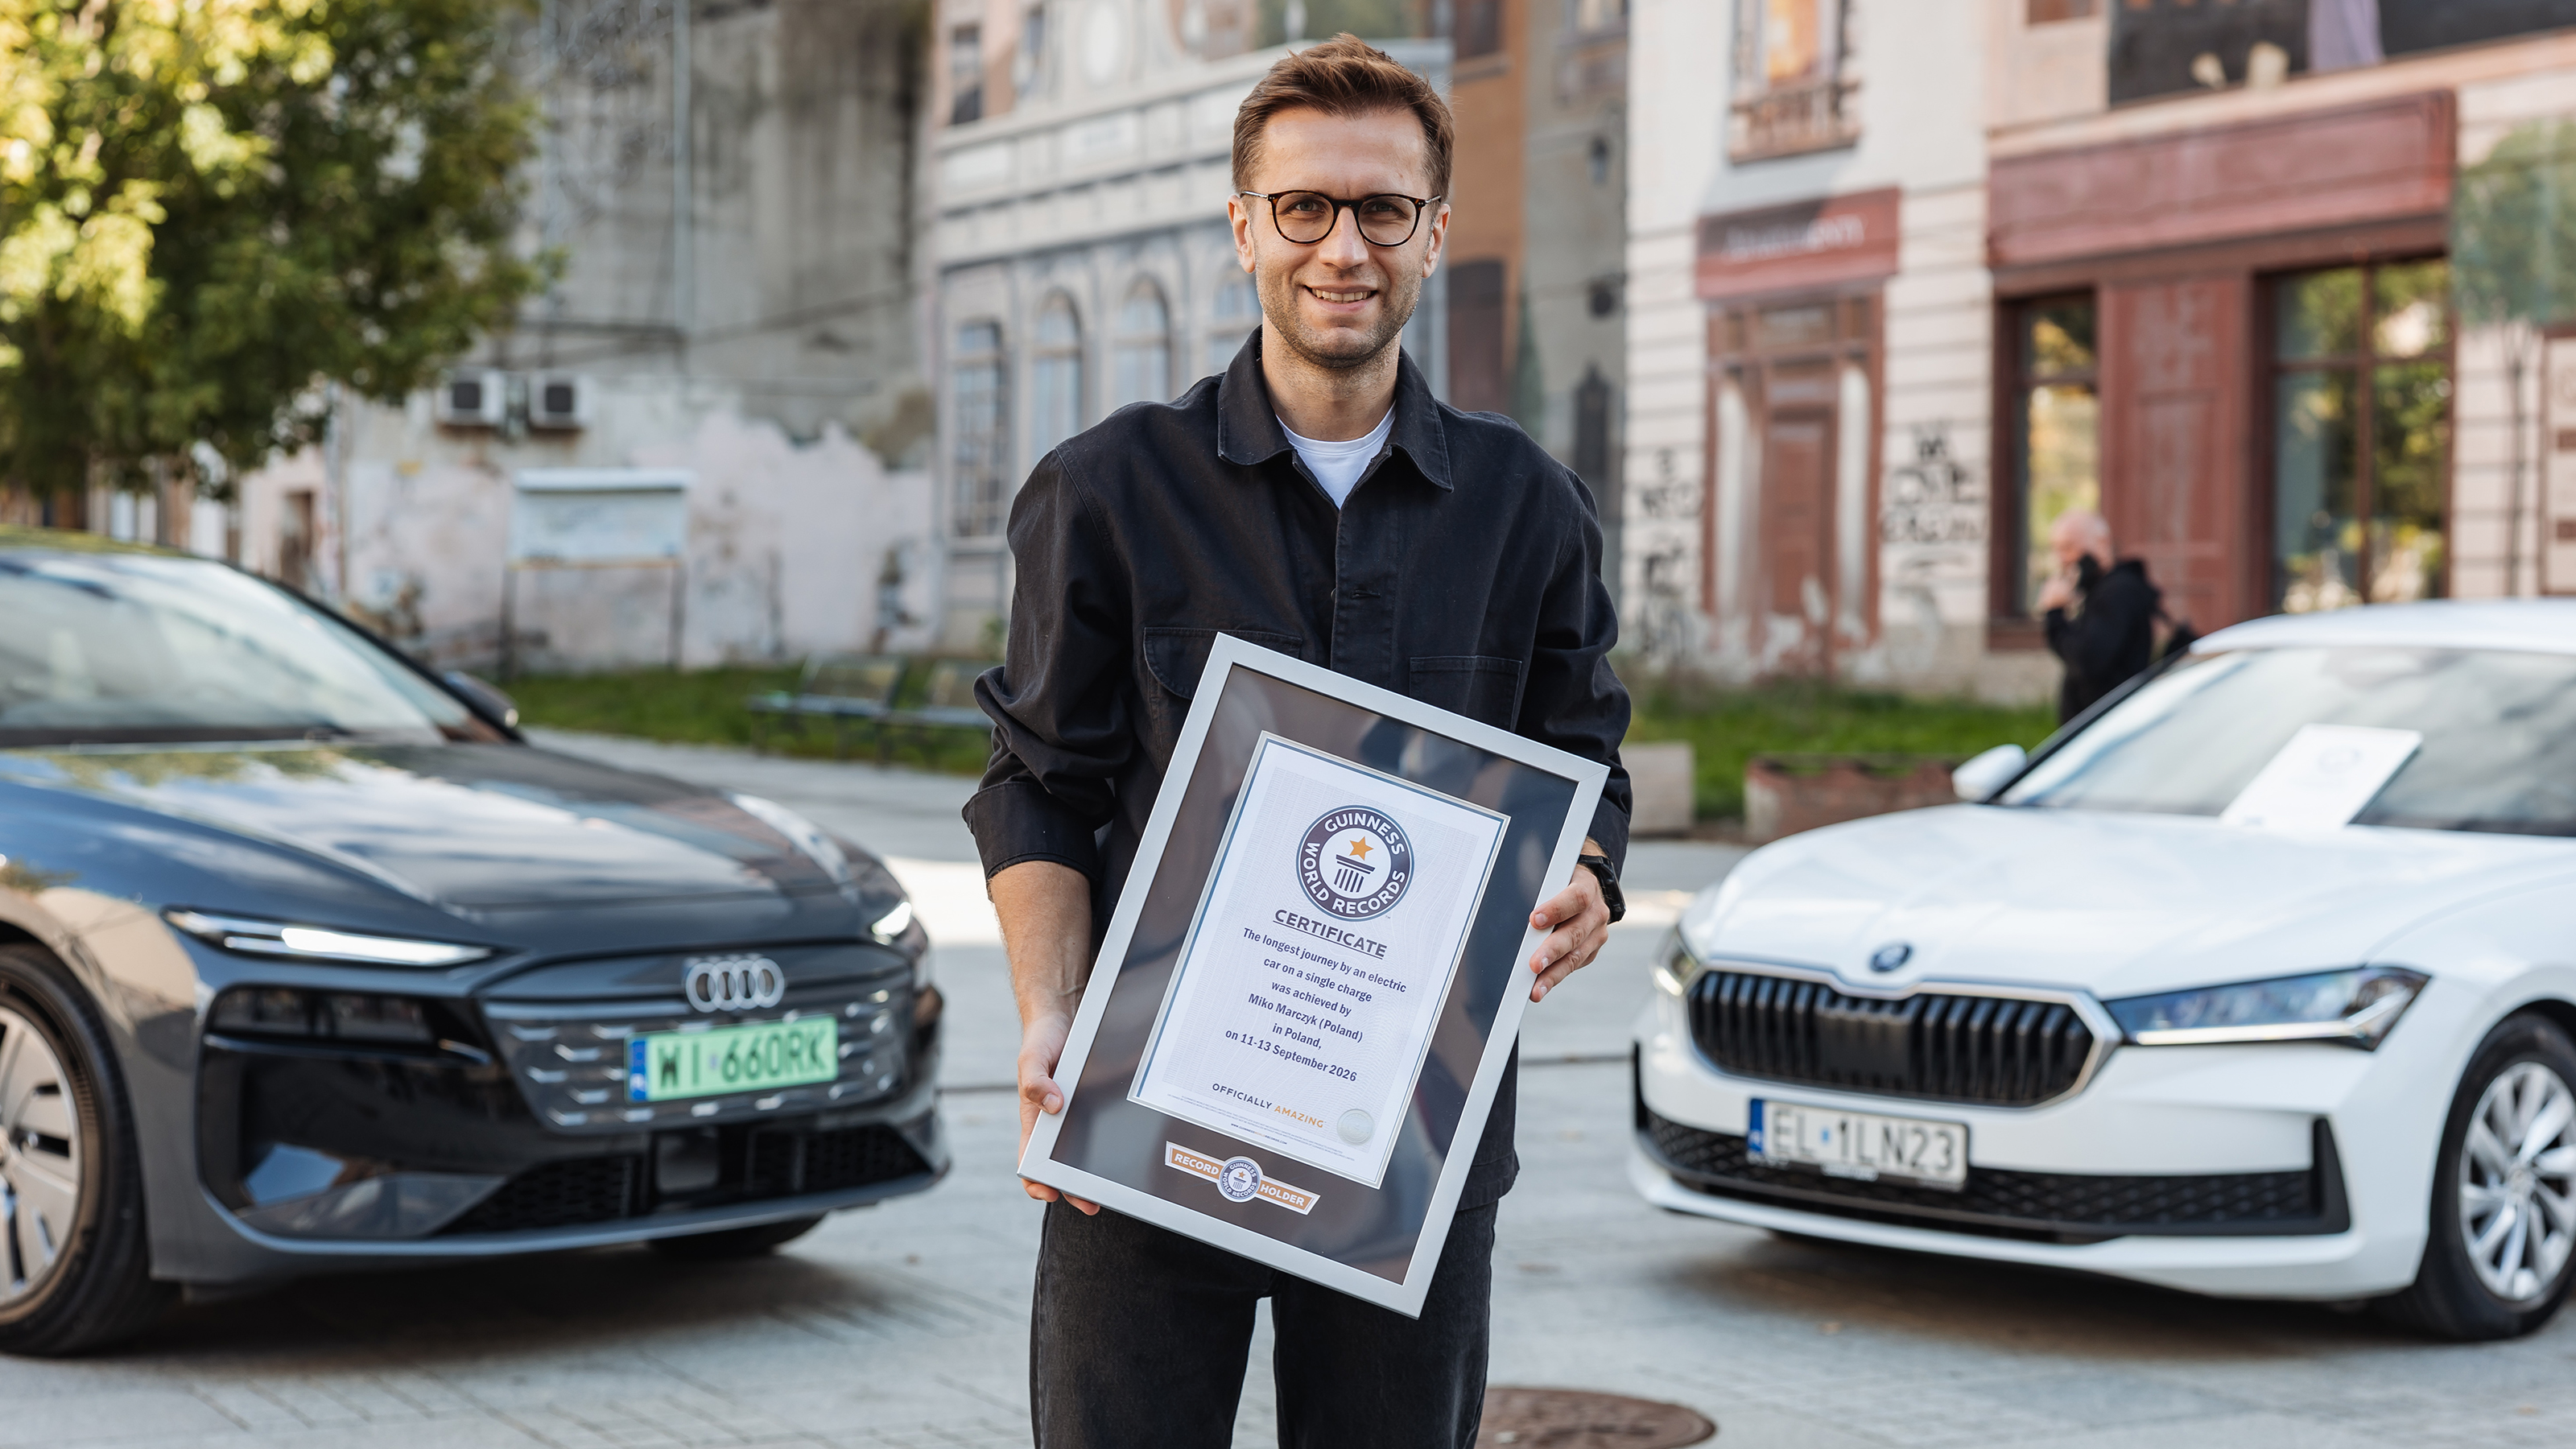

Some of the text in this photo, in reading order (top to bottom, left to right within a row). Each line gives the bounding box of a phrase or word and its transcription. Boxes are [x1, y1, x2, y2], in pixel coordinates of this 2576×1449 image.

[1324, 812, 1406, 855] GUINNESS
[1302, 842, 1406, 915] WORLD RECORDS
[1274, 909, 1388, 958] CERTIFICATE
[1243, 927, 1407, 993] The longest journey by an electric
[1263, 958, 1373, 1002] car on a single charge
[1248, 993, 1364, 1043] Miko Marczyk (Poland)
[1271, 981, 1352, 1018] was achieved by
[657, 1027, 828, 1091] WI 660RK
[1224, 1030, 1358, 1082] on 11-13 September 2026
[1272, 1022, 1322, 1050] in Poland,
[1212, 1083, 1324, 1129] OFFICIALLY AMAZING
[1773, 1109, 1955, 1172] EL 1LN23
[1174, 1153, 1306, 1207] RECORD HOLDER
[1222, 1172, 1257, 1198] WORLD RECORDS
[1229, 1162, 1257, 1179] GUINNESS
